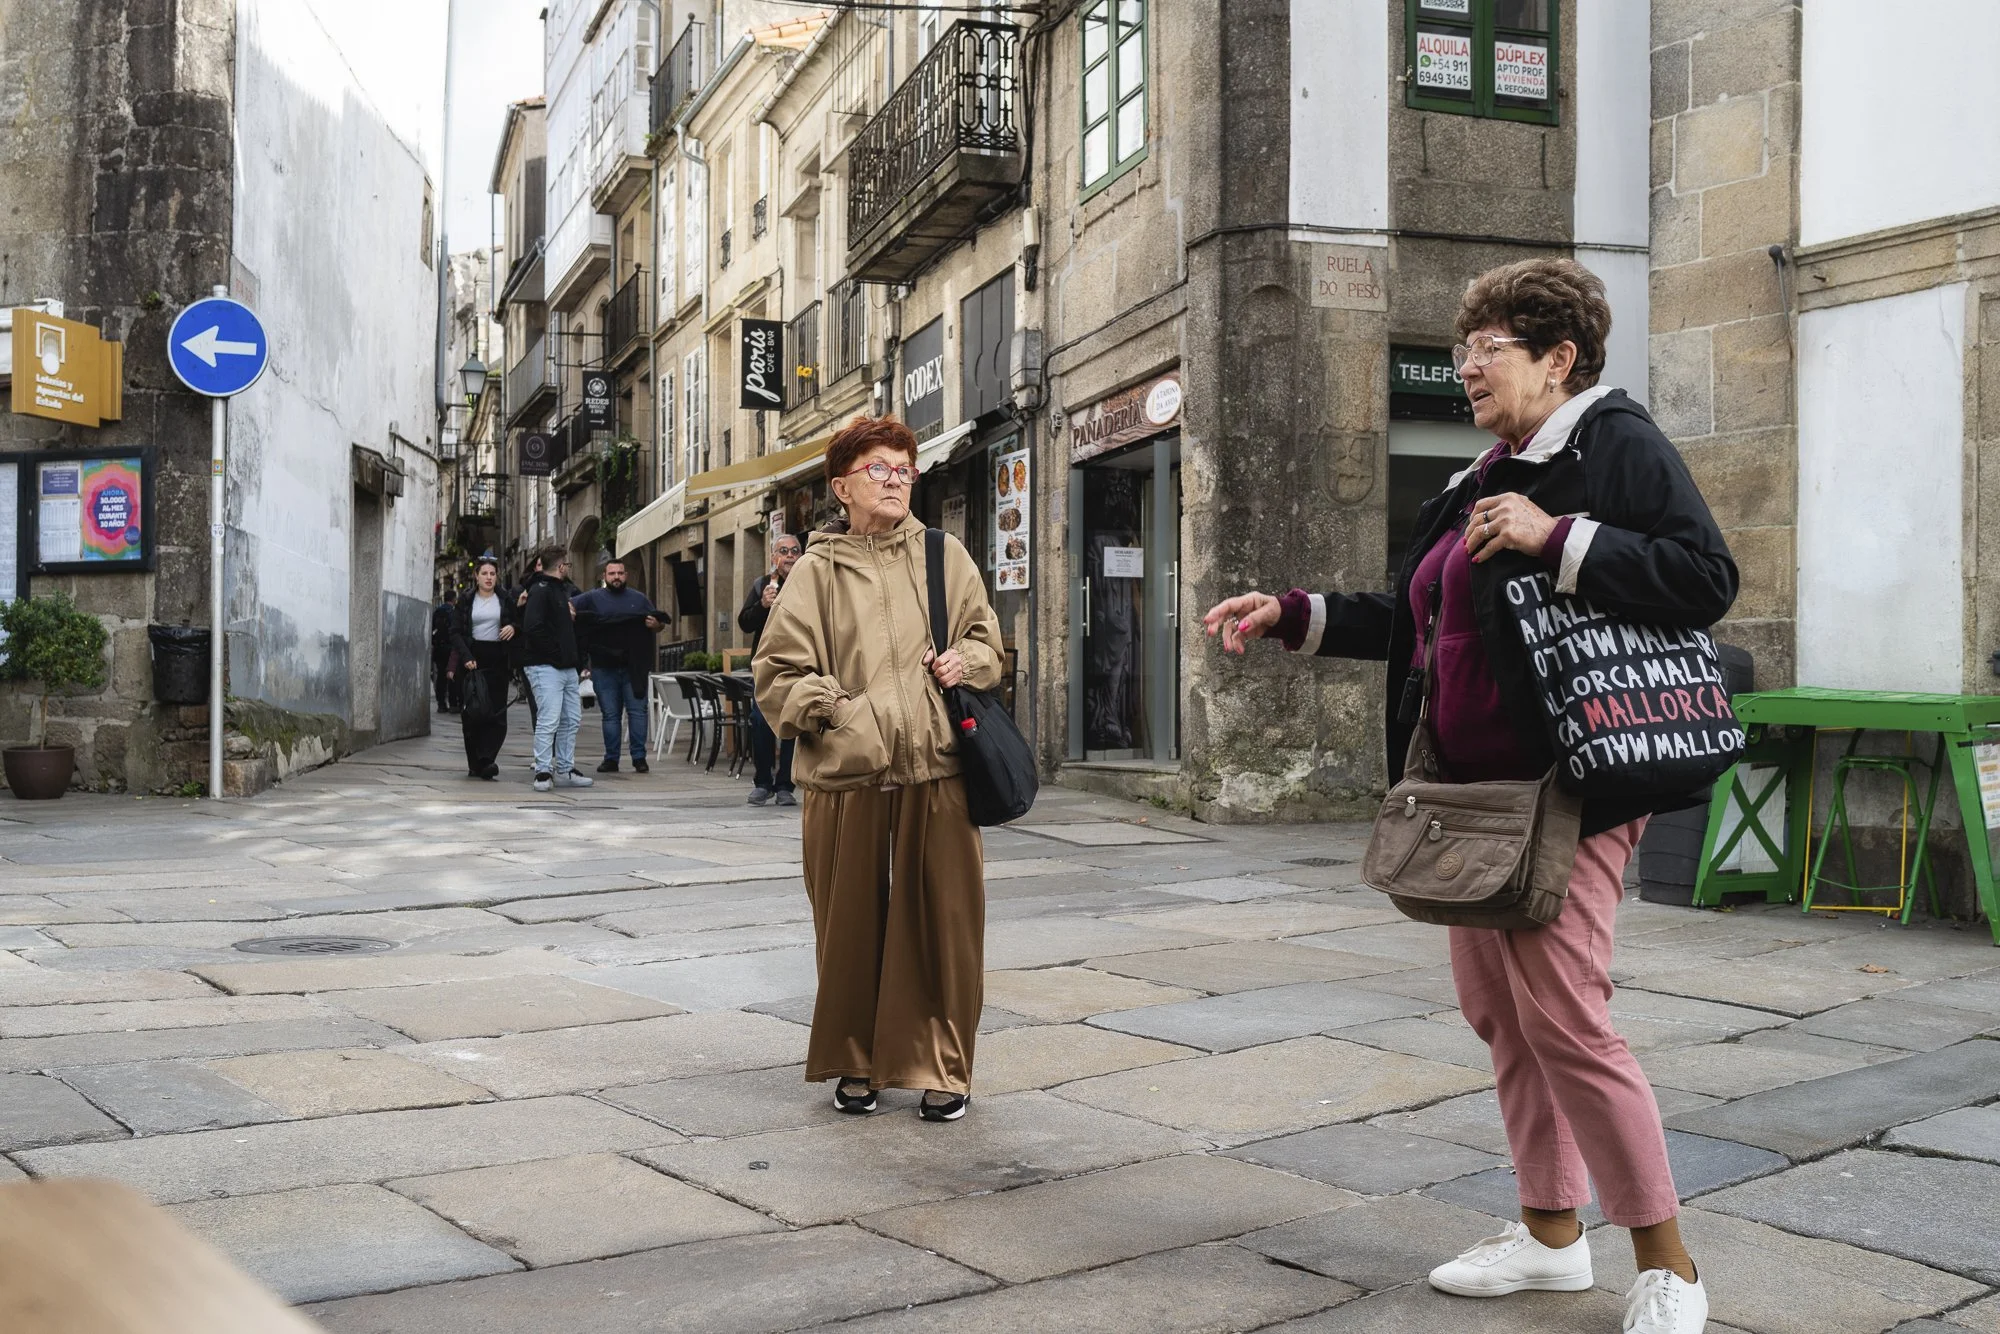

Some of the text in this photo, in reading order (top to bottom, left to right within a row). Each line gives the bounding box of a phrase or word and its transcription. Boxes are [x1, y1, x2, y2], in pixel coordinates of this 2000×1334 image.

[1419, 37, 1469, 57] ALQUILA
[1496, 45, 1546, 66] DÚPLEX
[1452, 60, 1468, 72] 911
[1496, 63, 1545, 78] APTO PROF.
[1419, 71, 1469, 87] 6949 3145
[1496, 73, 1545, 86] +VIVIENDA
[1496, 84, 1546, 97] A REFORMAR
[1327, 255, 1373, 275] RUELA
[1319, 280, 1381, 299] DO PESO
[766, 330, 775, 373] CAFÉ BAR
[744, 328, 781, 403] paris
[1398, 363, 1465, 384] TELEFO
[904, 354, 945, 408] CODEX
[585, 397, 610, 405] REDES
[1072, 398, 1143, 449] PANADERÍA
[101, 489, 124, 497] AHORA
[98, 512, 127, 520] DURANTE
[111, 504, 124, 512] MES
[109, 519, 125, 528] AÑOS
[1535, 598, 1620, 641] MALL
[1582, 685, 1733, 733] MALLORCA
